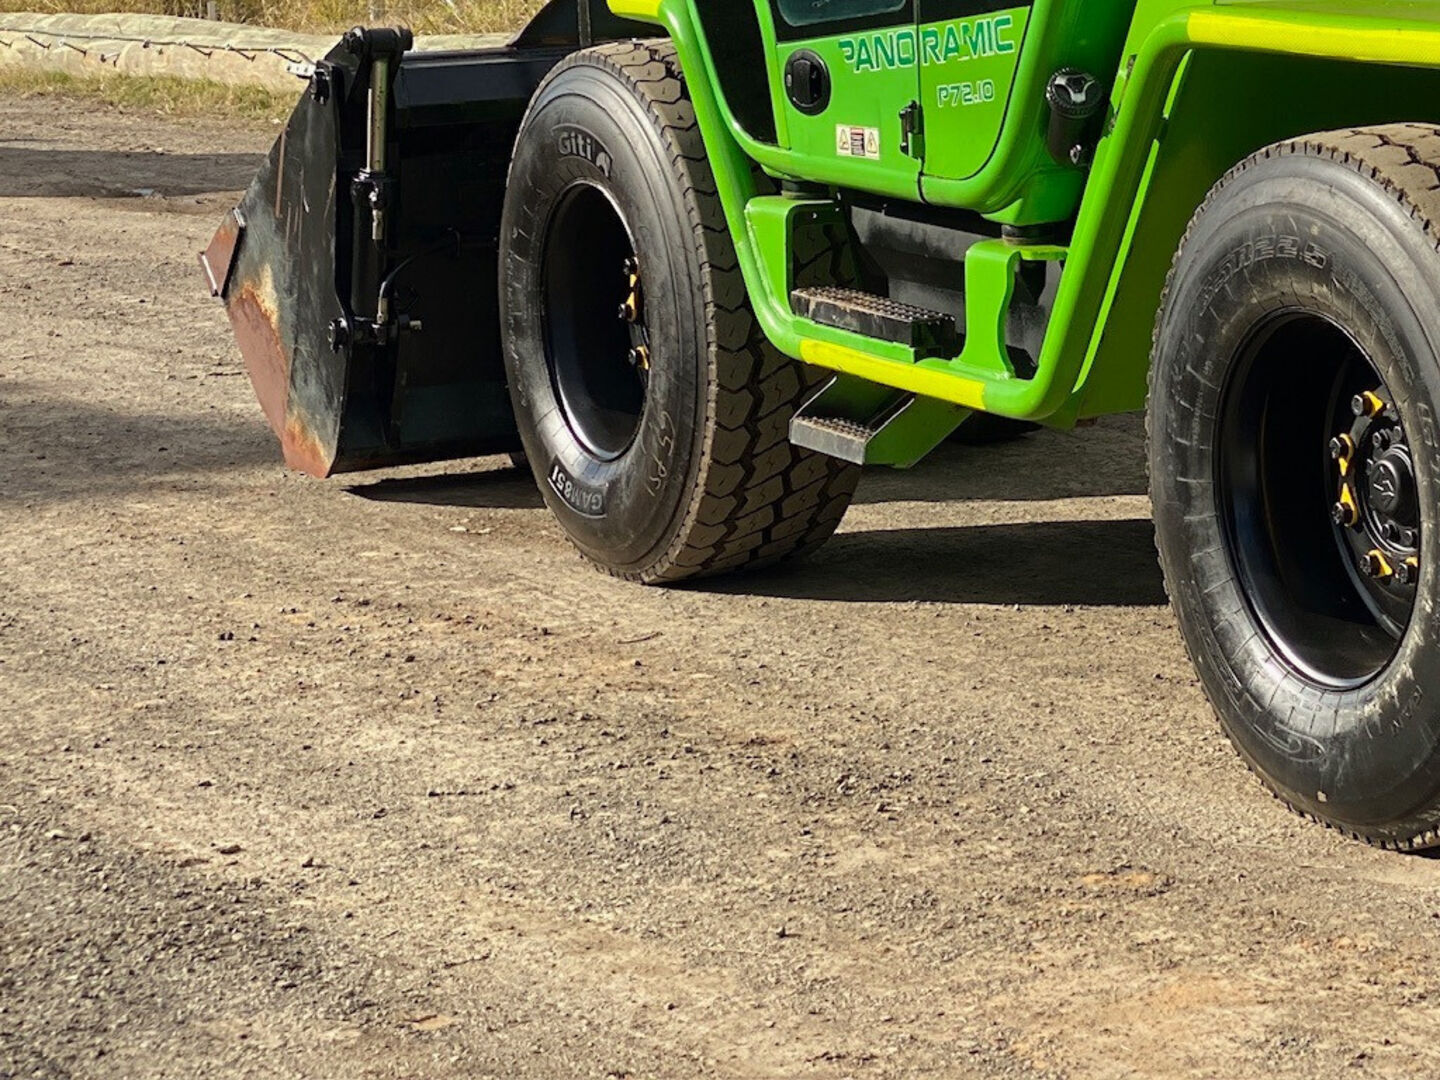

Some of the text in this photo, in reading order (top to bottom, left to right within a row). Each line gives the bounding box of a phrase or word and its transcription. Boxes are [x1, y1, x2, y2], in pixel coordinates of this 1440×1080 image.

[838, 15, 1014, 73] PANORAMIC
[937, 78, 995, 108] P72.10
[558, 130, 592, 160] Giti
[552, 465, 604, 511] GAM851
